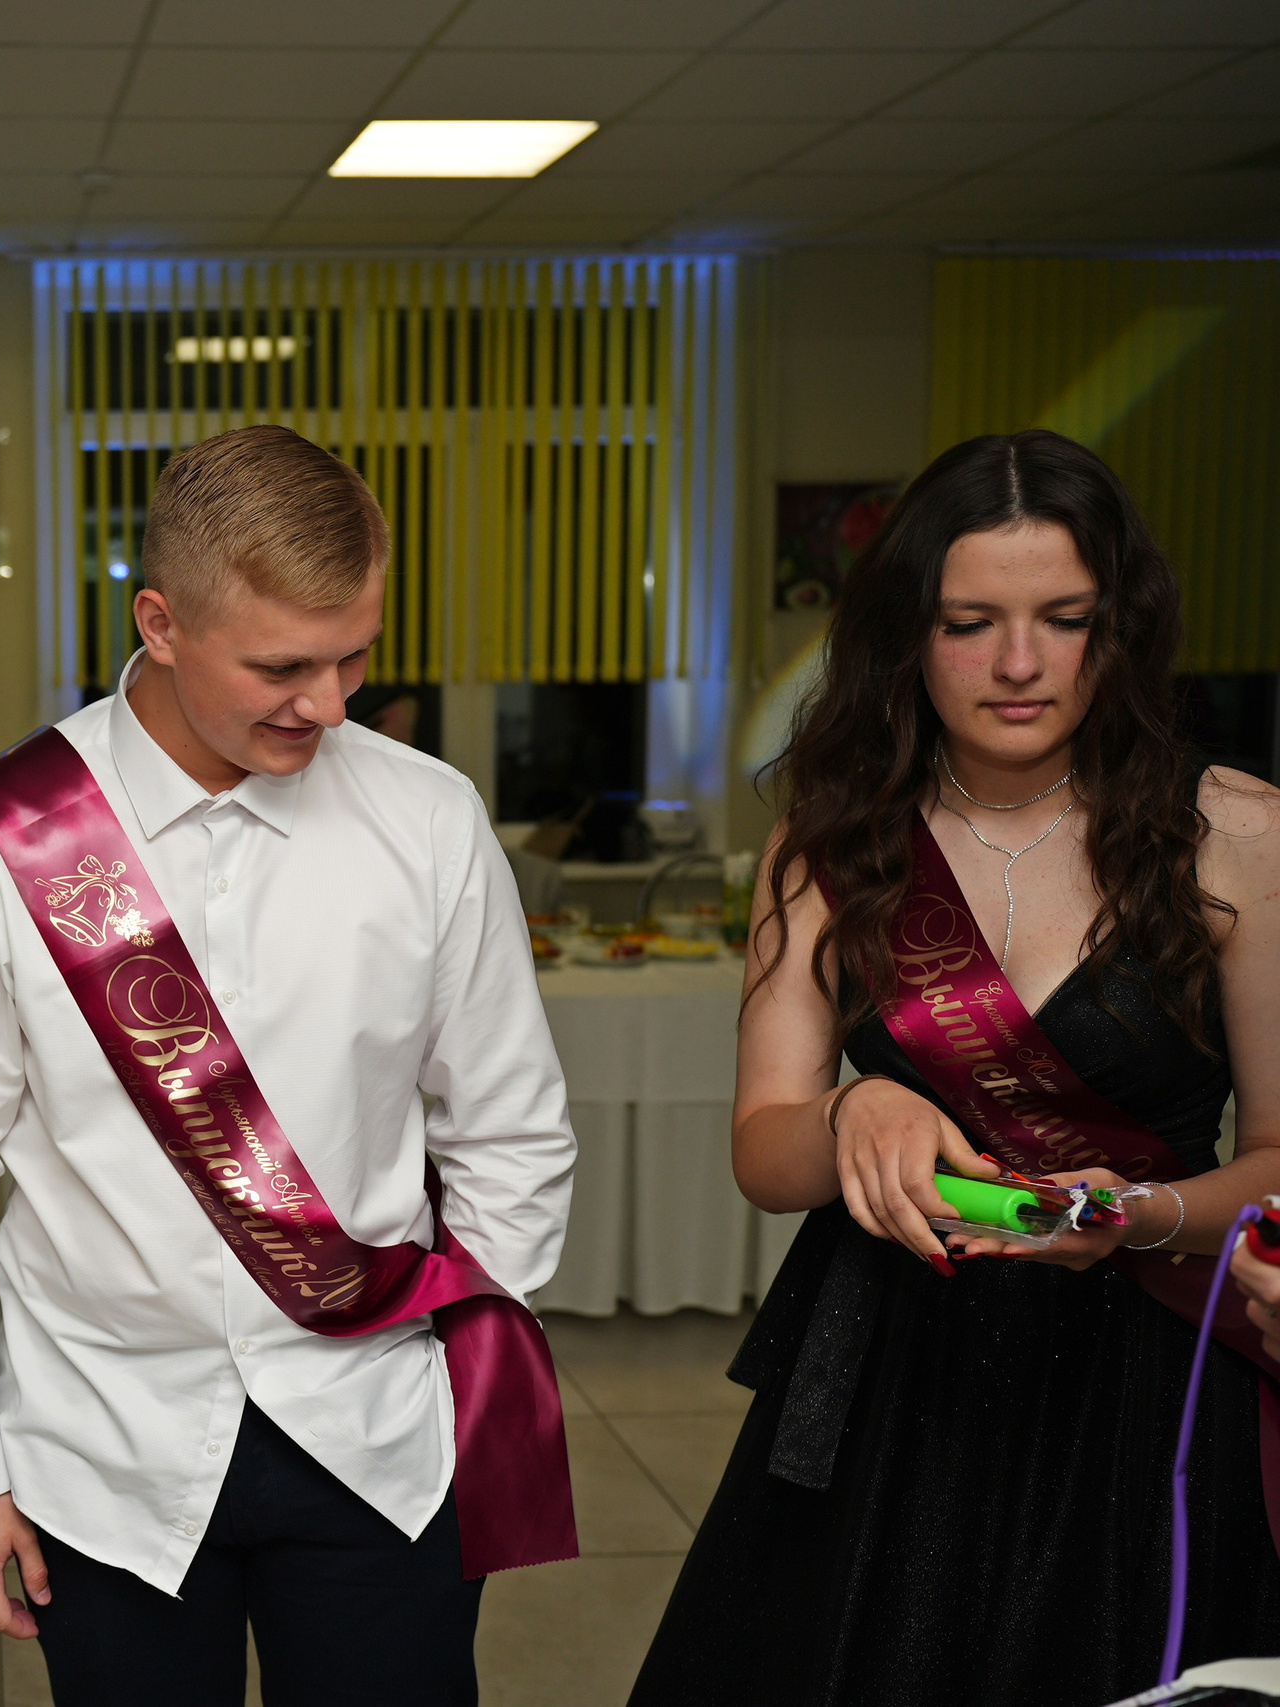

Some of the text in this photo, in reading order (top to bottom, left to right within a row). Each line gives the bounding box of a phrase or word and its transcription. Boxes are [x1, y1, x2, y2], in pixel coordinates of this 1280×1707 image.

[891, 1014, 920, 1049] класс
[969, 980, 1062, 1096] Ерохина Юлия
[106, 954, 318, 1279] Выпускник
[137, 1097, 162, 1130] класс
[209, 1060, 324, 1247] Лукьянский Артём
